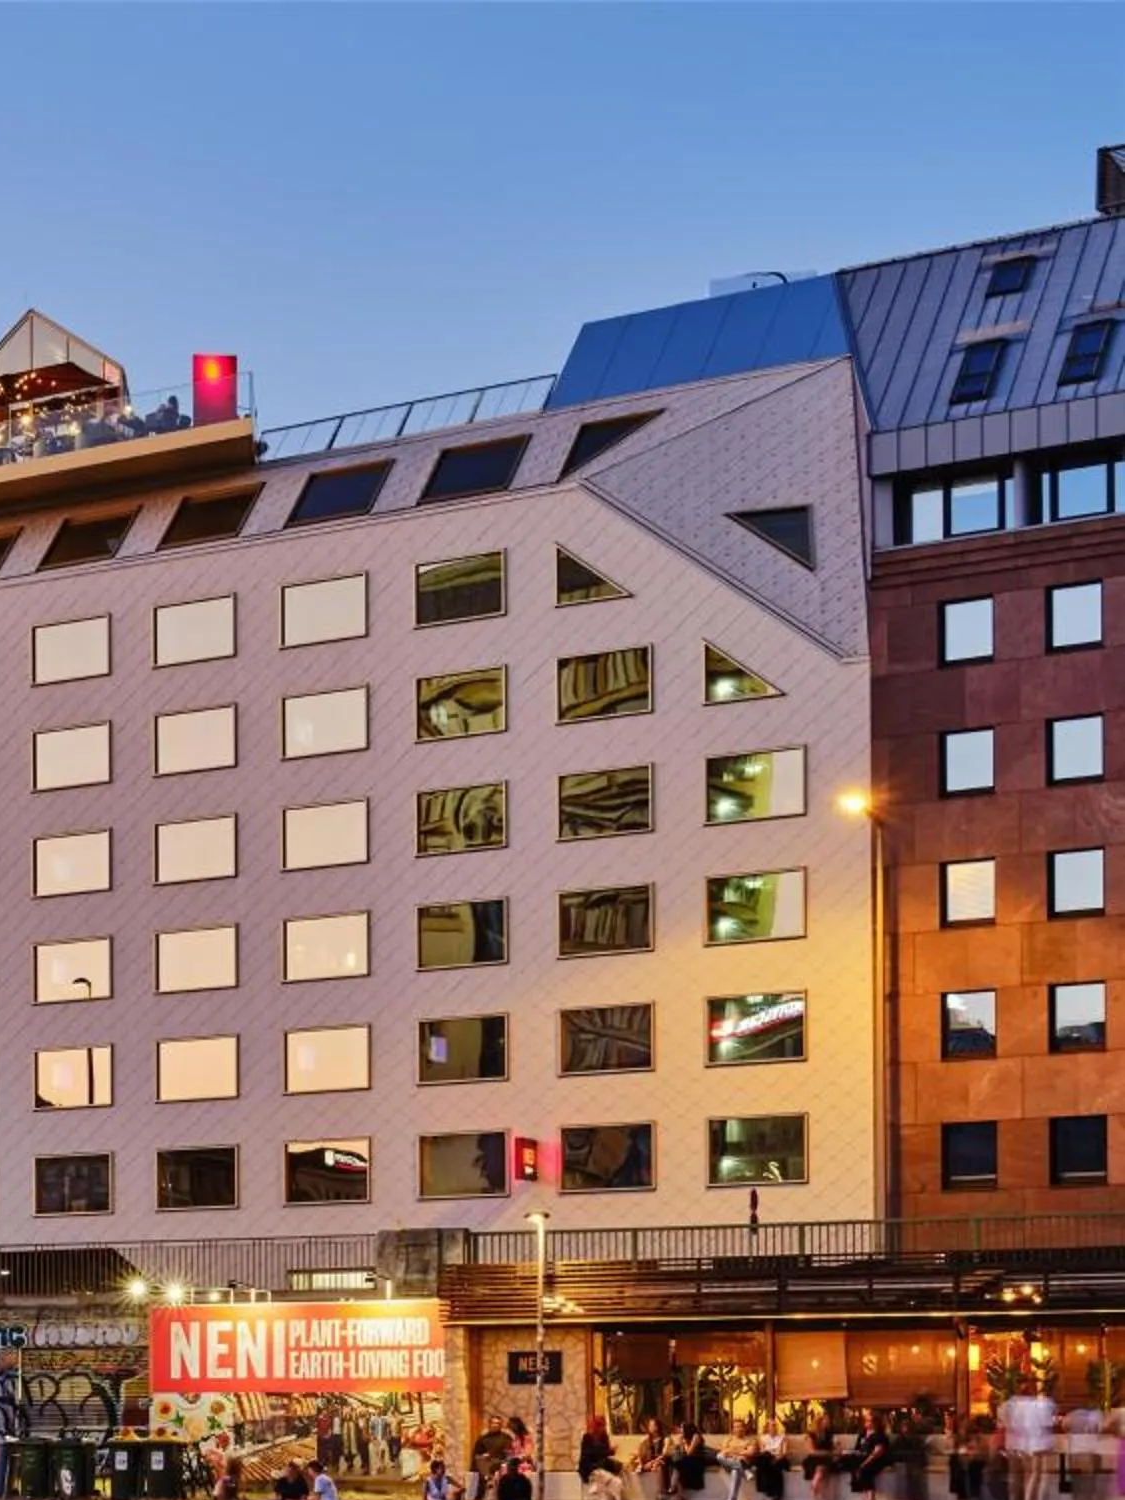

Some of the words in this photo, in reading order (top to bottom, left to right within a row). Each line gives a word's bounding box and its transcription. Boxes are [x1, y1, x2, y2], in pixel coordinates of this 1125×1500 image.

[289, 1317, 430, 1347] PLANT-FORWARD
[170, 1318, 286, 1379] NENI
[289, 1349, 409, 1379] EARTH-LOVING
[518, 1357, 550, 1371] NEI
